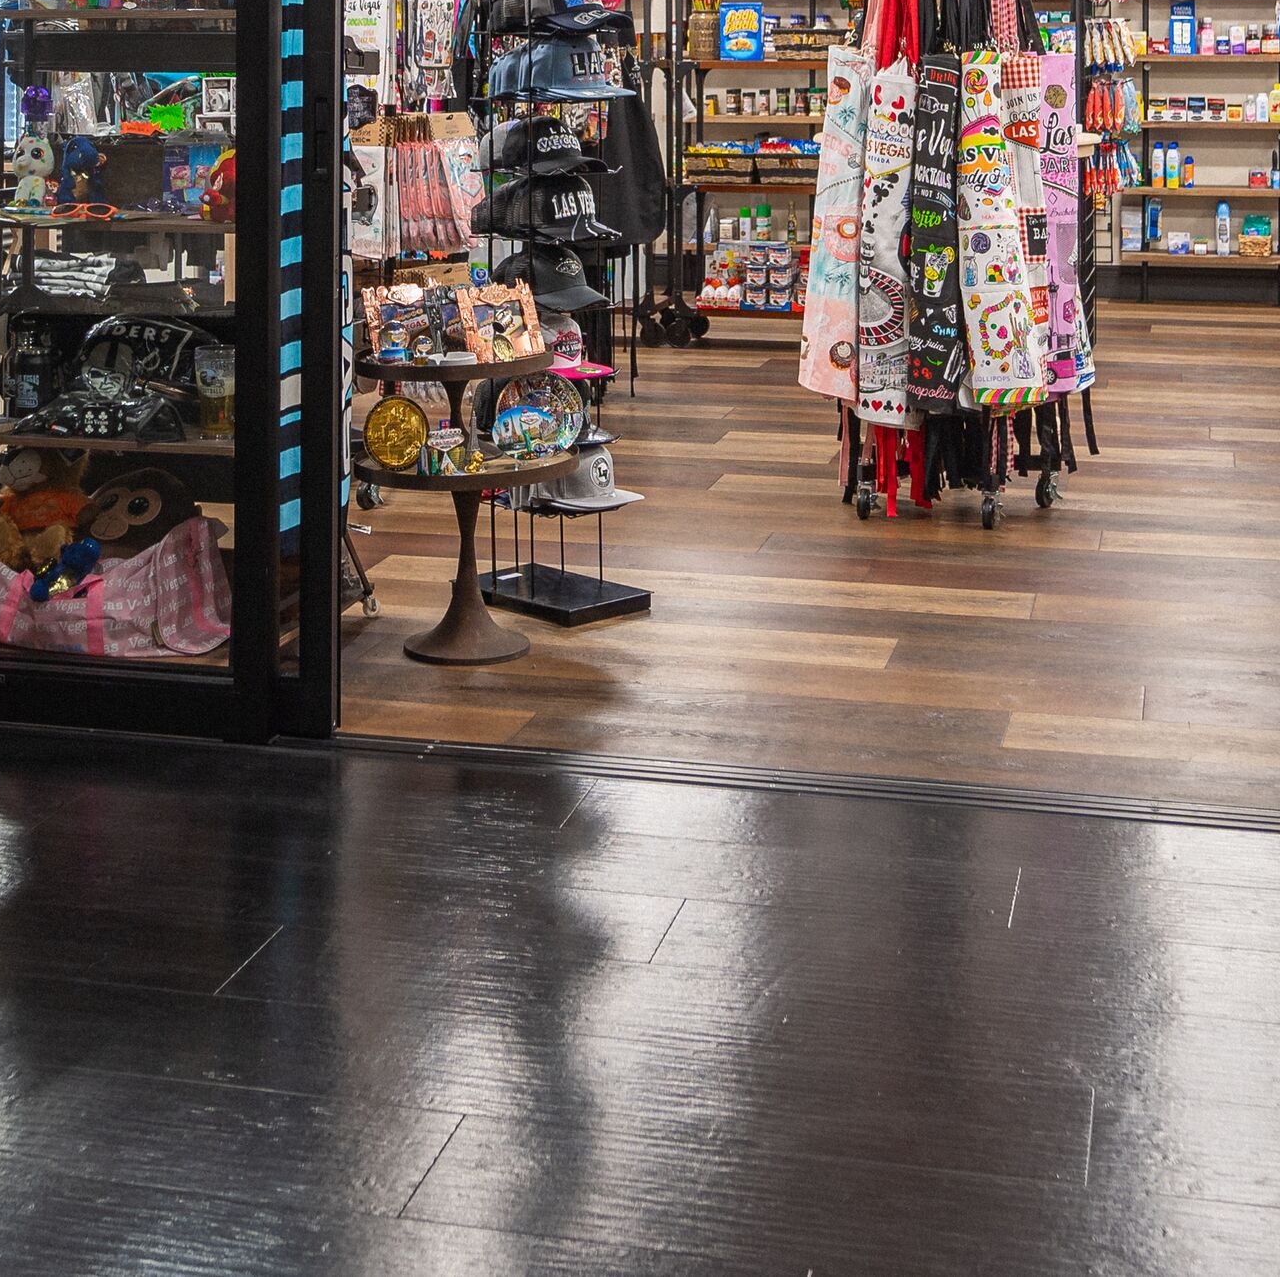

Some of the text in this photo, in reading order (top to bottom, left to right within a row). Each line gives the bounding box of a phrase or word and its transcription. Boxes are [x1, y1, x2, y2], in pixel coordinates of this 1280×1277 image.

[1006, 93, 1037, 110] JOIN US
[1012, 125, 1036, 138] LAS
[1040, 112, 1073, 155] Las
[874, 142, 911, 159] VEGAS
[1040, 157, 1077, 173] PART
[921, 189, 933, 198] NOT
[552, 192, 578, 220] LAS
[922, 338, 948, 352] juice
[60, 621, 88, 634] Vega
